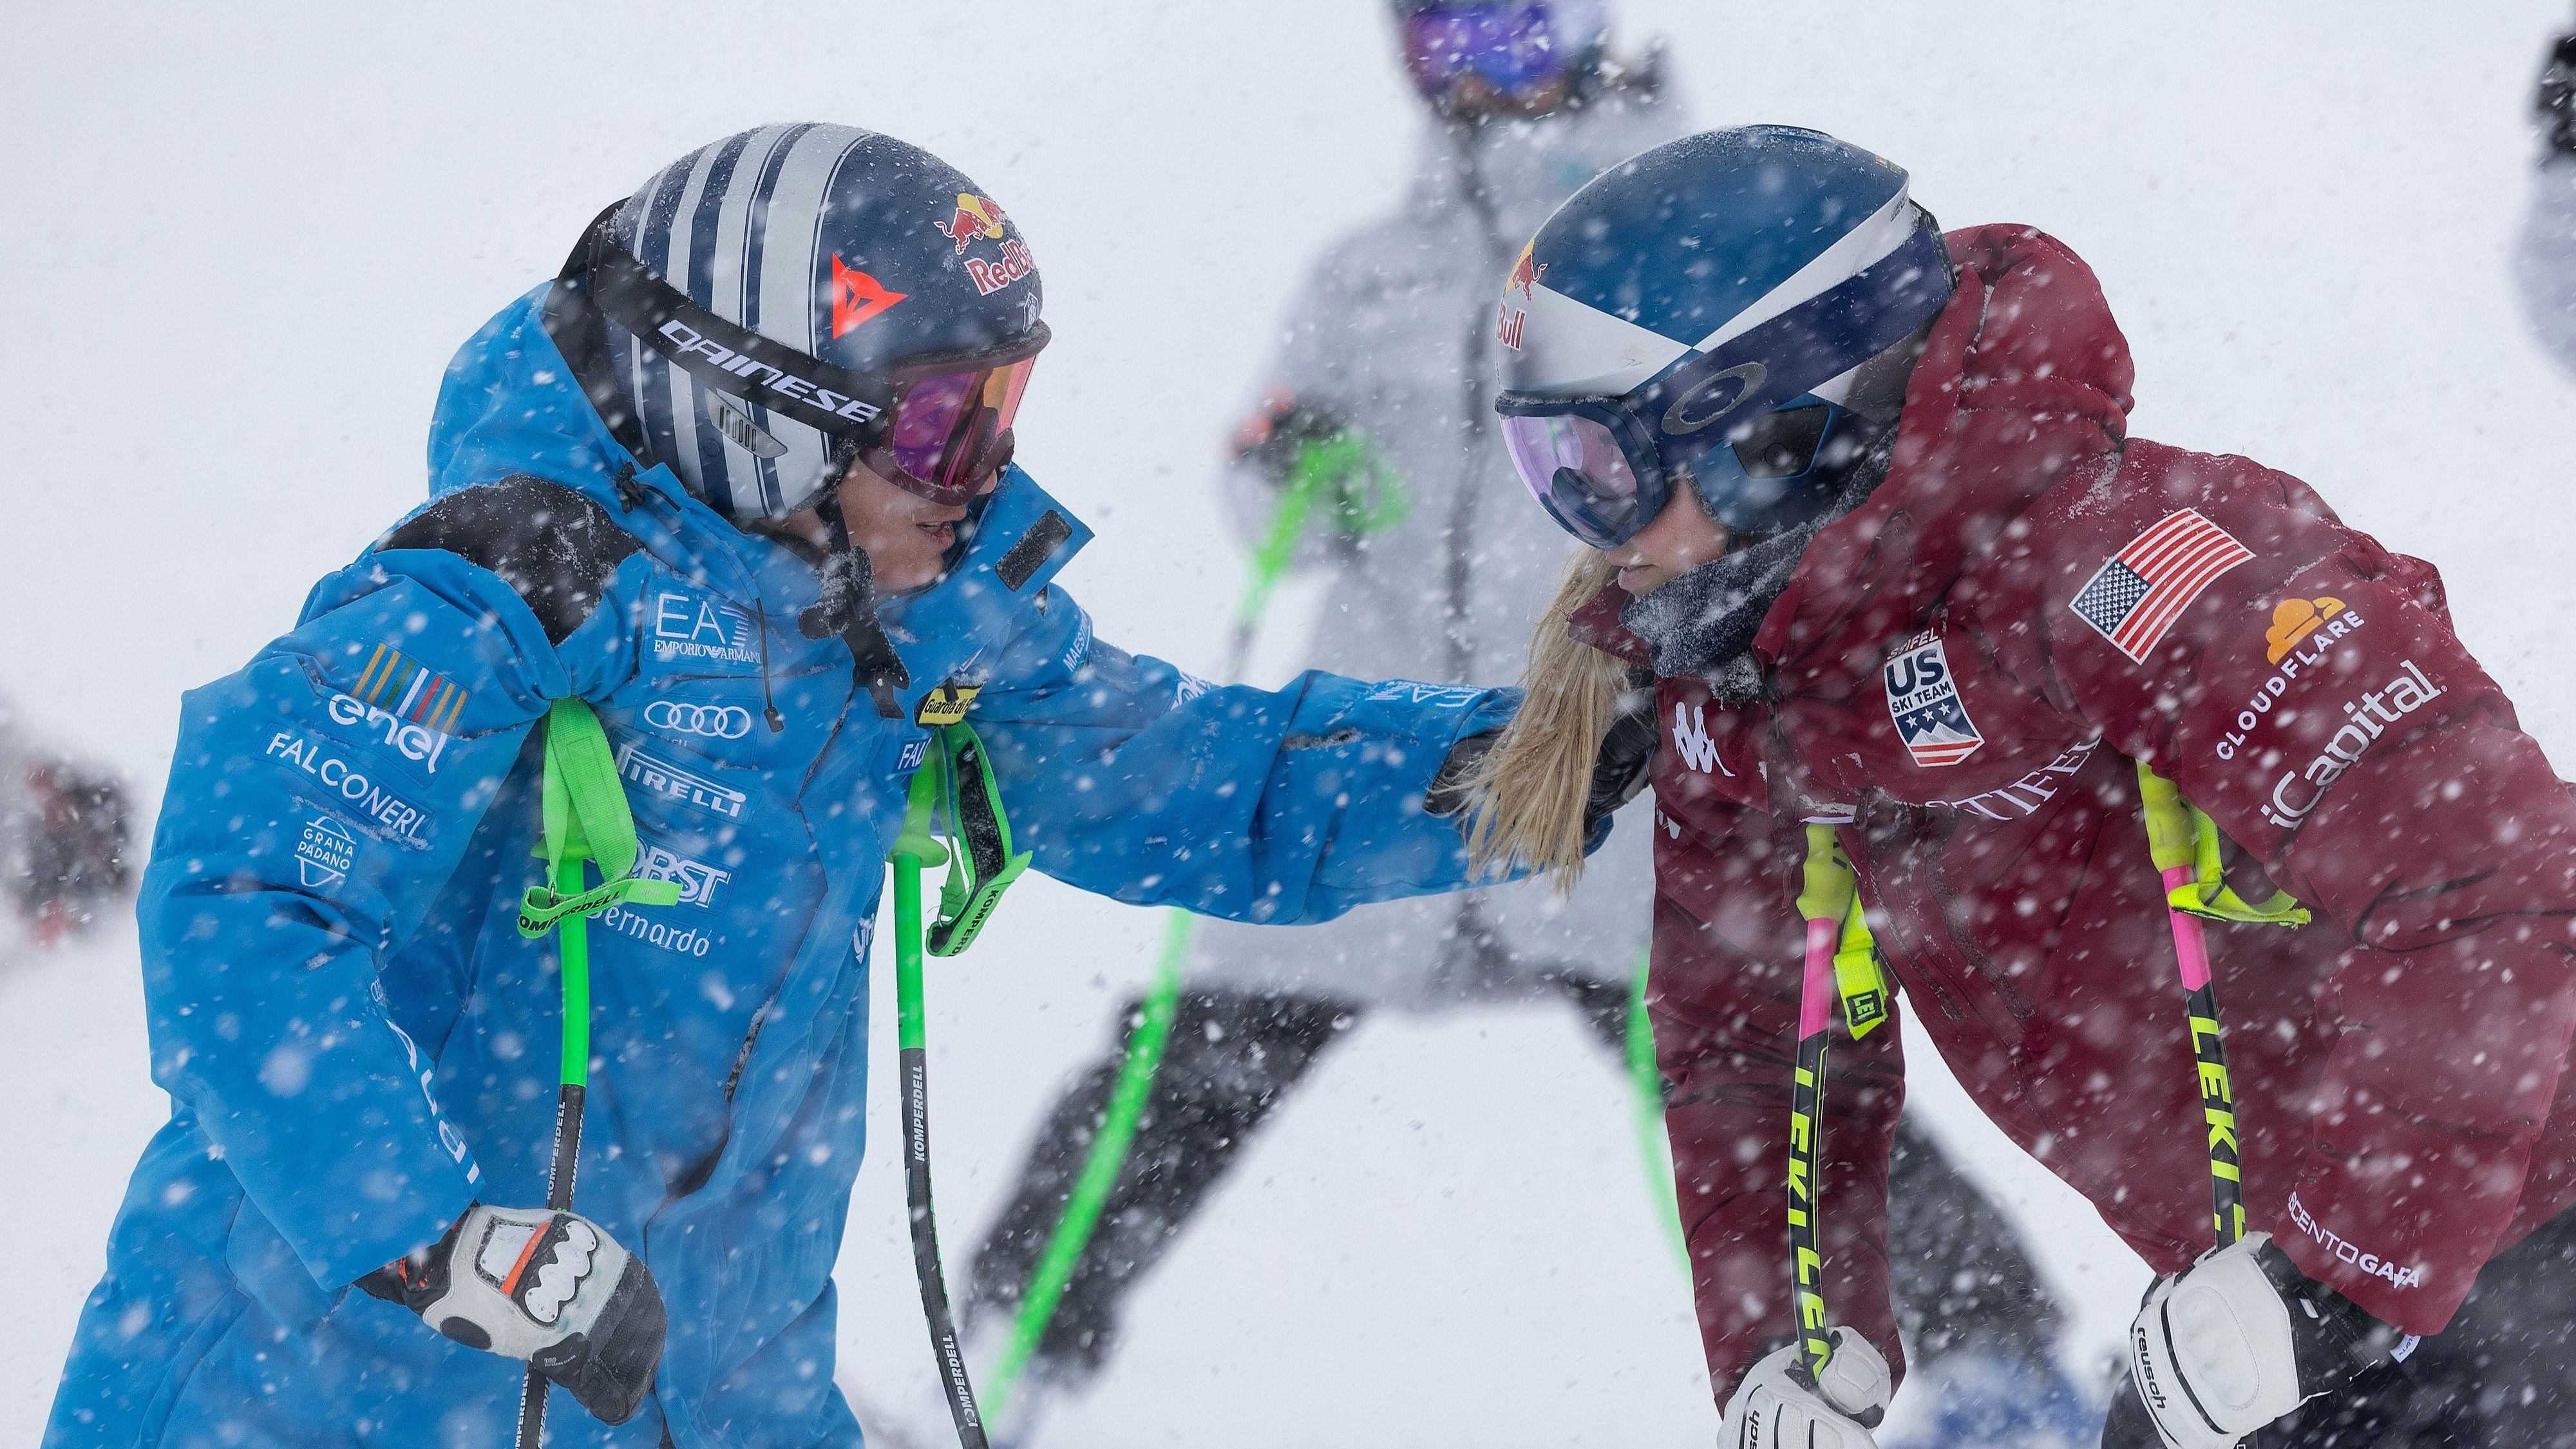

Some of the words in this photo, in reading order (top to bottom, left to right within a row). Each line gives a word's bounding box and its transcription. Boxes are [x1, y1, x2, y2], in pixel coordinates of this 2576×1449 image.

[1496, 304, 1526, 351] Bull
[658, 319, 882, 422] DAINESE
[654, 639, 705, 658] EMPORIO
[720, 647, 761, 663] ARMANI
[656, 593, 748, 647] EA7
[1886, 649, 1944, 697] US
[1891, 696, 1913, 713] SKI
[1915, 681, 1952, 704] TEAM
[2216, 610, 2365, 761] CLOUDFLARE
[329, 694, 448, 773] enel
[2261, 659, 2441, 831] iCapital
[266, 733, 426, 837] FALCONERI
[617, 743, 746, 817] PIRELLI
[298, 841, 350, 871] PADANO
[303, 828, 354, 857] GRANA
[586, 905, 709, 956] ernardo
[913, 1065, 925, 1162] KOMPERDELL
[2190, 1016, 2240, 1183] LEKI
[547, 1102, 565, 1200] KOMPERDELL
[2137, 1327, 2166, 1408] reusch
